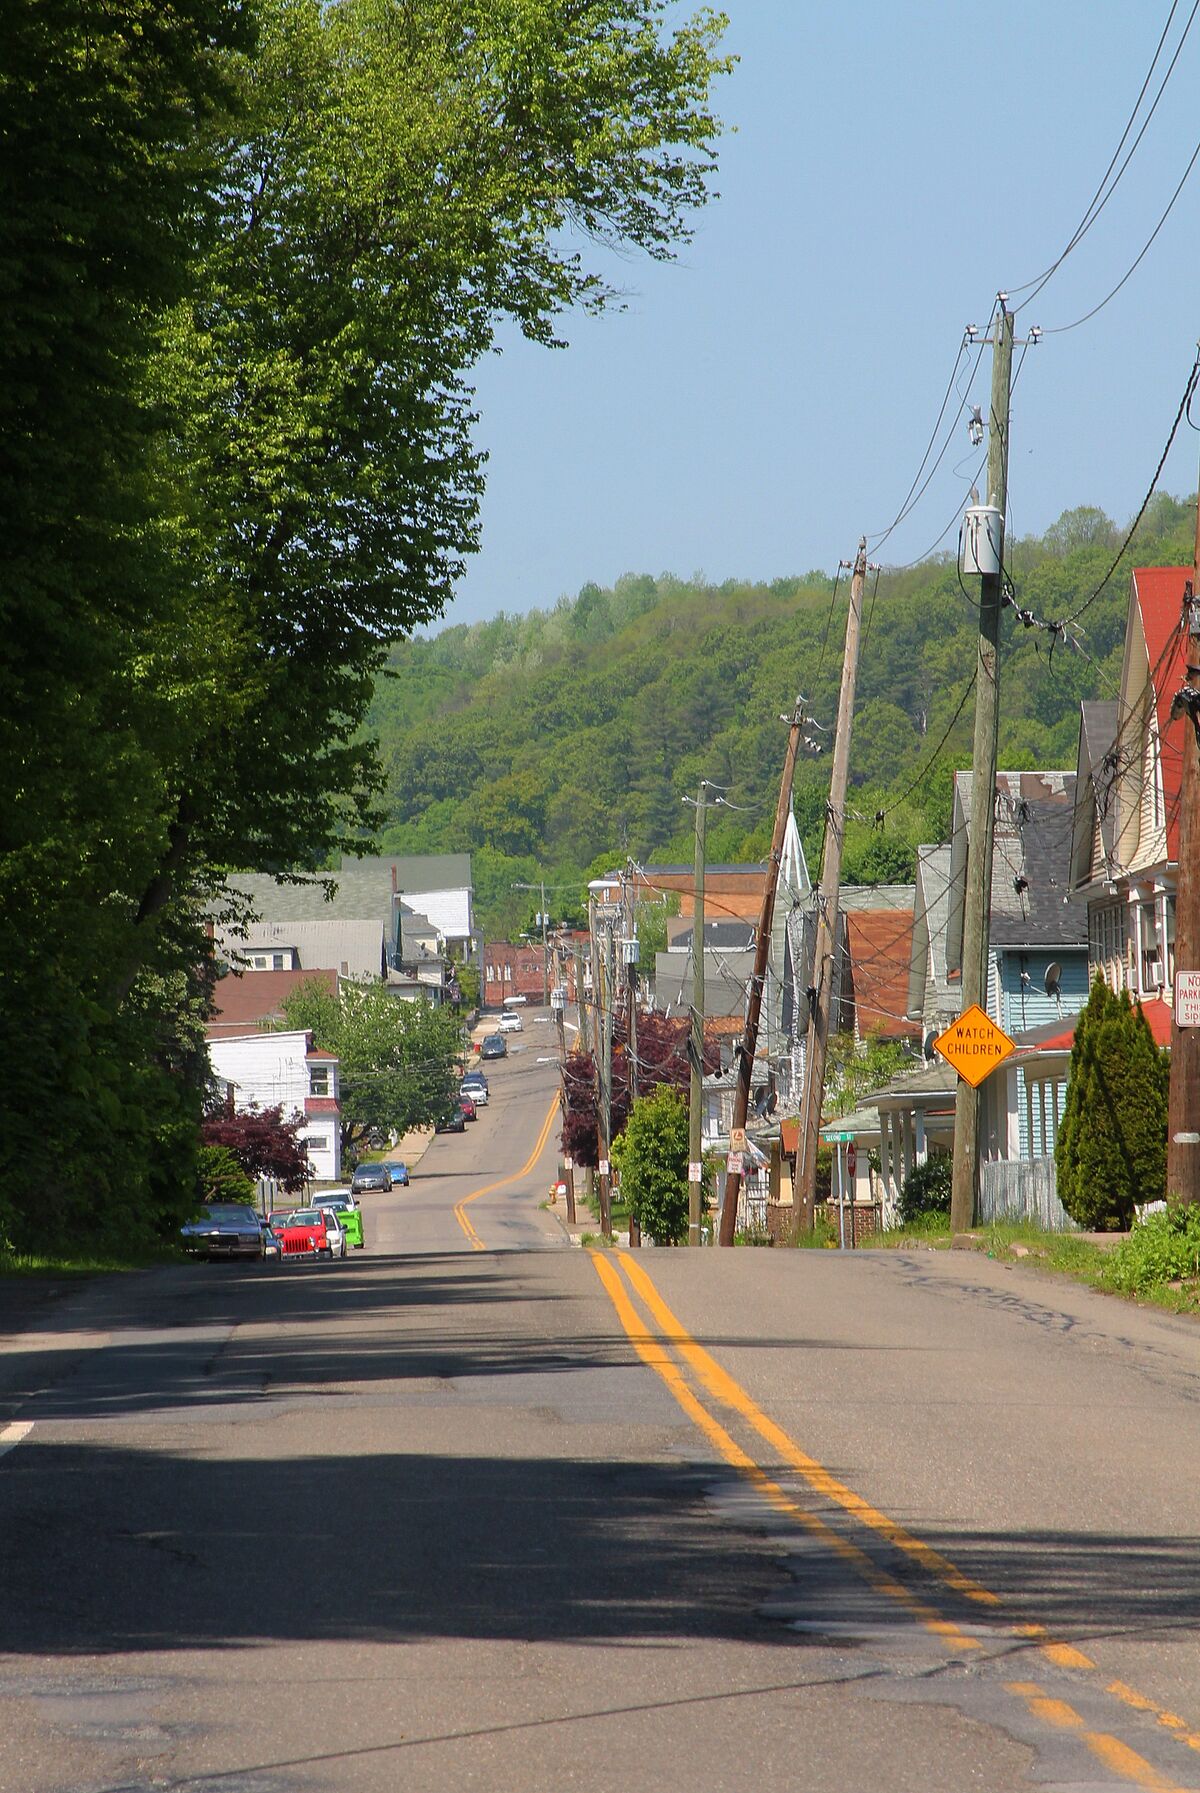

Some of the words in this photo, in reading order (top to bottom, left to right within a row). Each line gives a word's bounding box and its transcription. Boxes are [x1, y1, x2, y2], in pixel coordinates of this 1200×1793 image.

[1188, 976, 1200, 986] NO
[1185, 1003, 1200, 1011] THI
[956, 1028, 994, 1039] WATCH
[947, 1043, 1002, 1055] CHILDREN
